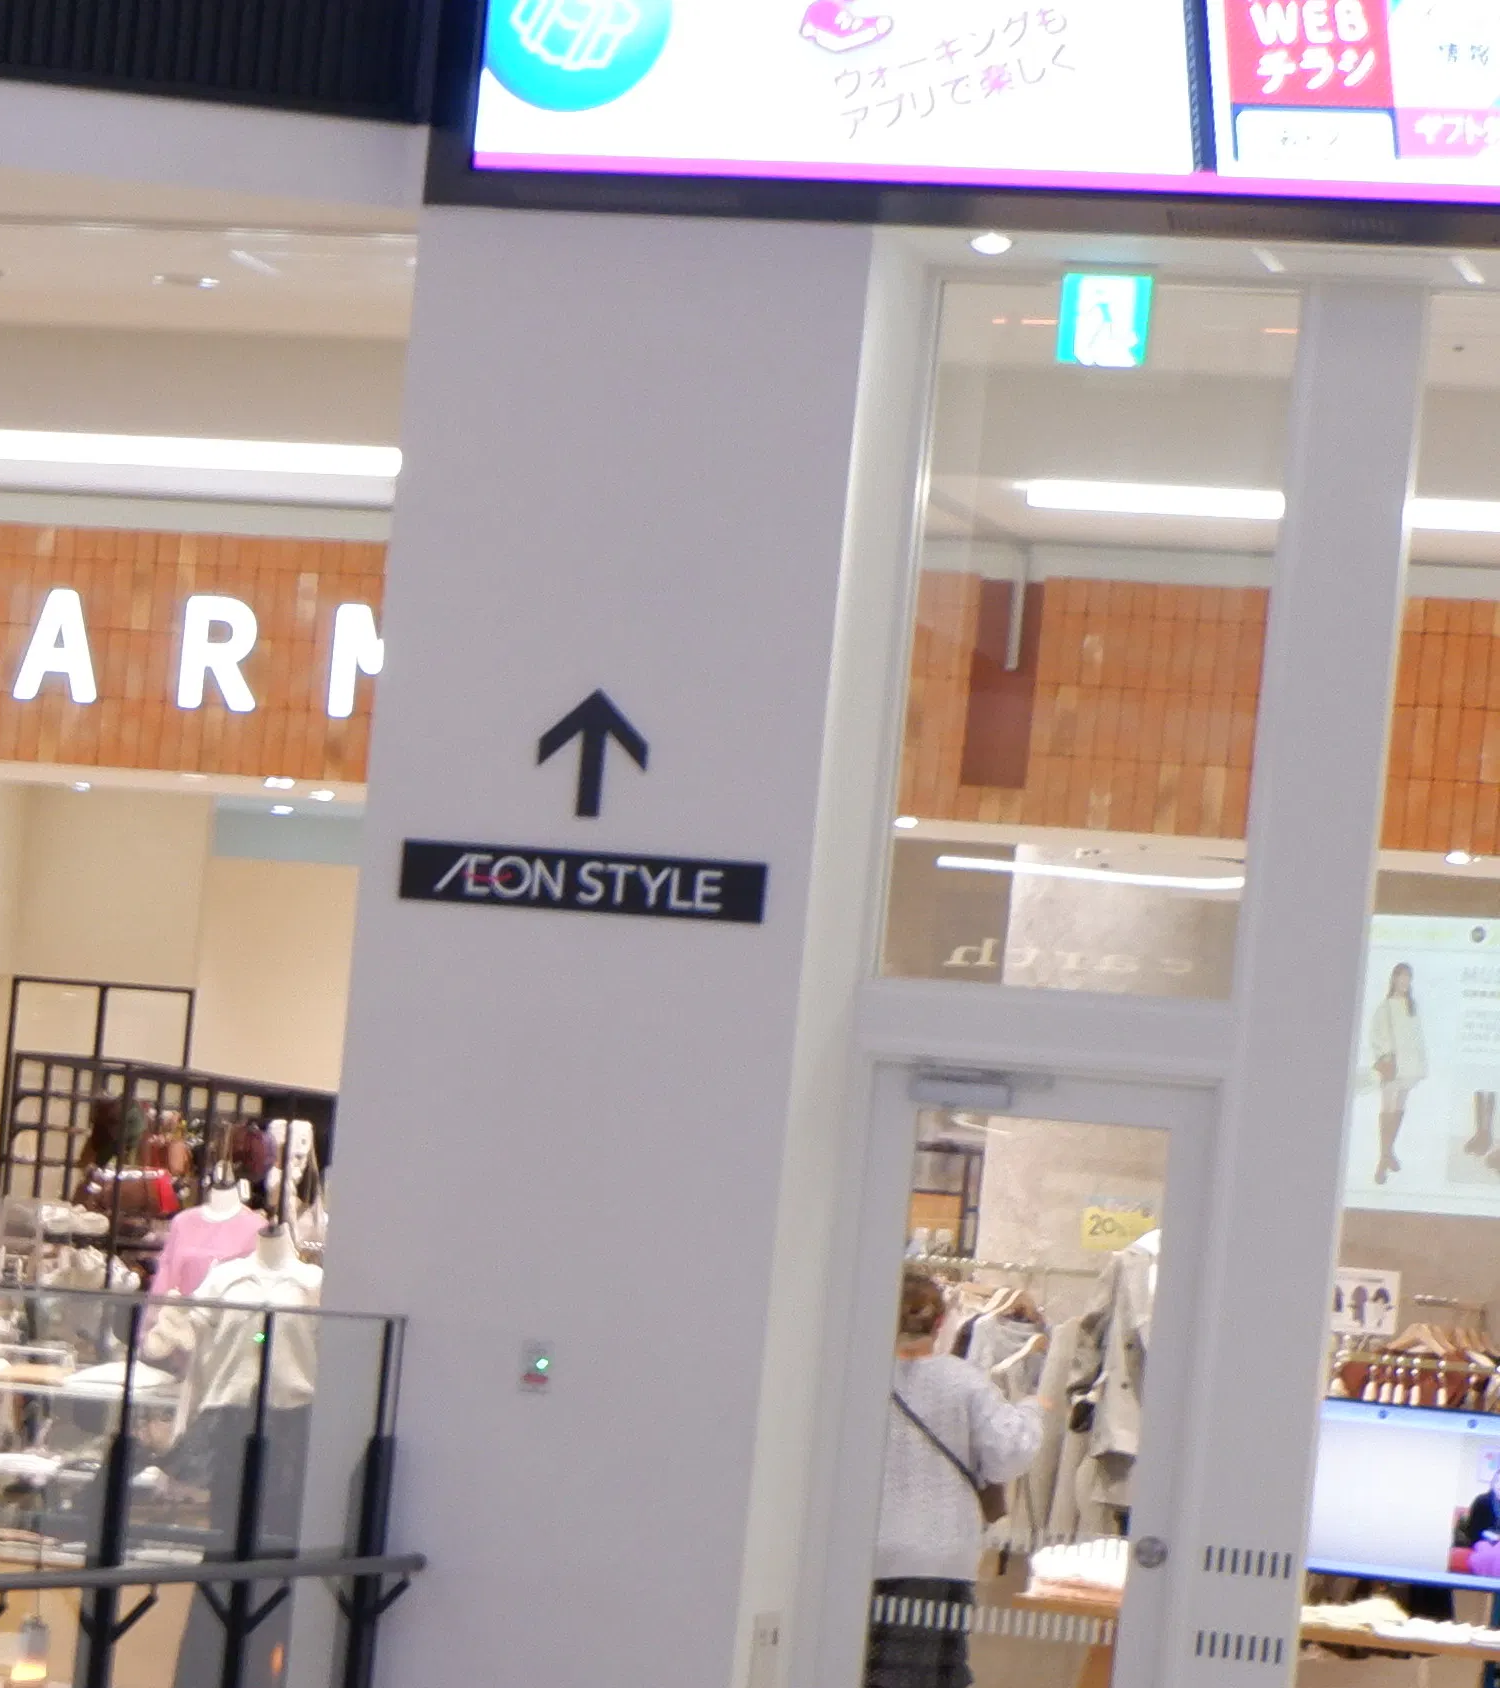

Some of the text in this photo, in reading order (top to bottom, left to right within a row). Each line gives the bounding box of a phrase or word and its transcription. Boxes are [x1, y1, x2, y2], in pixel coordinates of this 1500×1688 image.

[1249, 0, 1369, 45] WEB
[1256, 47, 1376, 95] チラシ
[576, 860, 724, 914] STYLE
